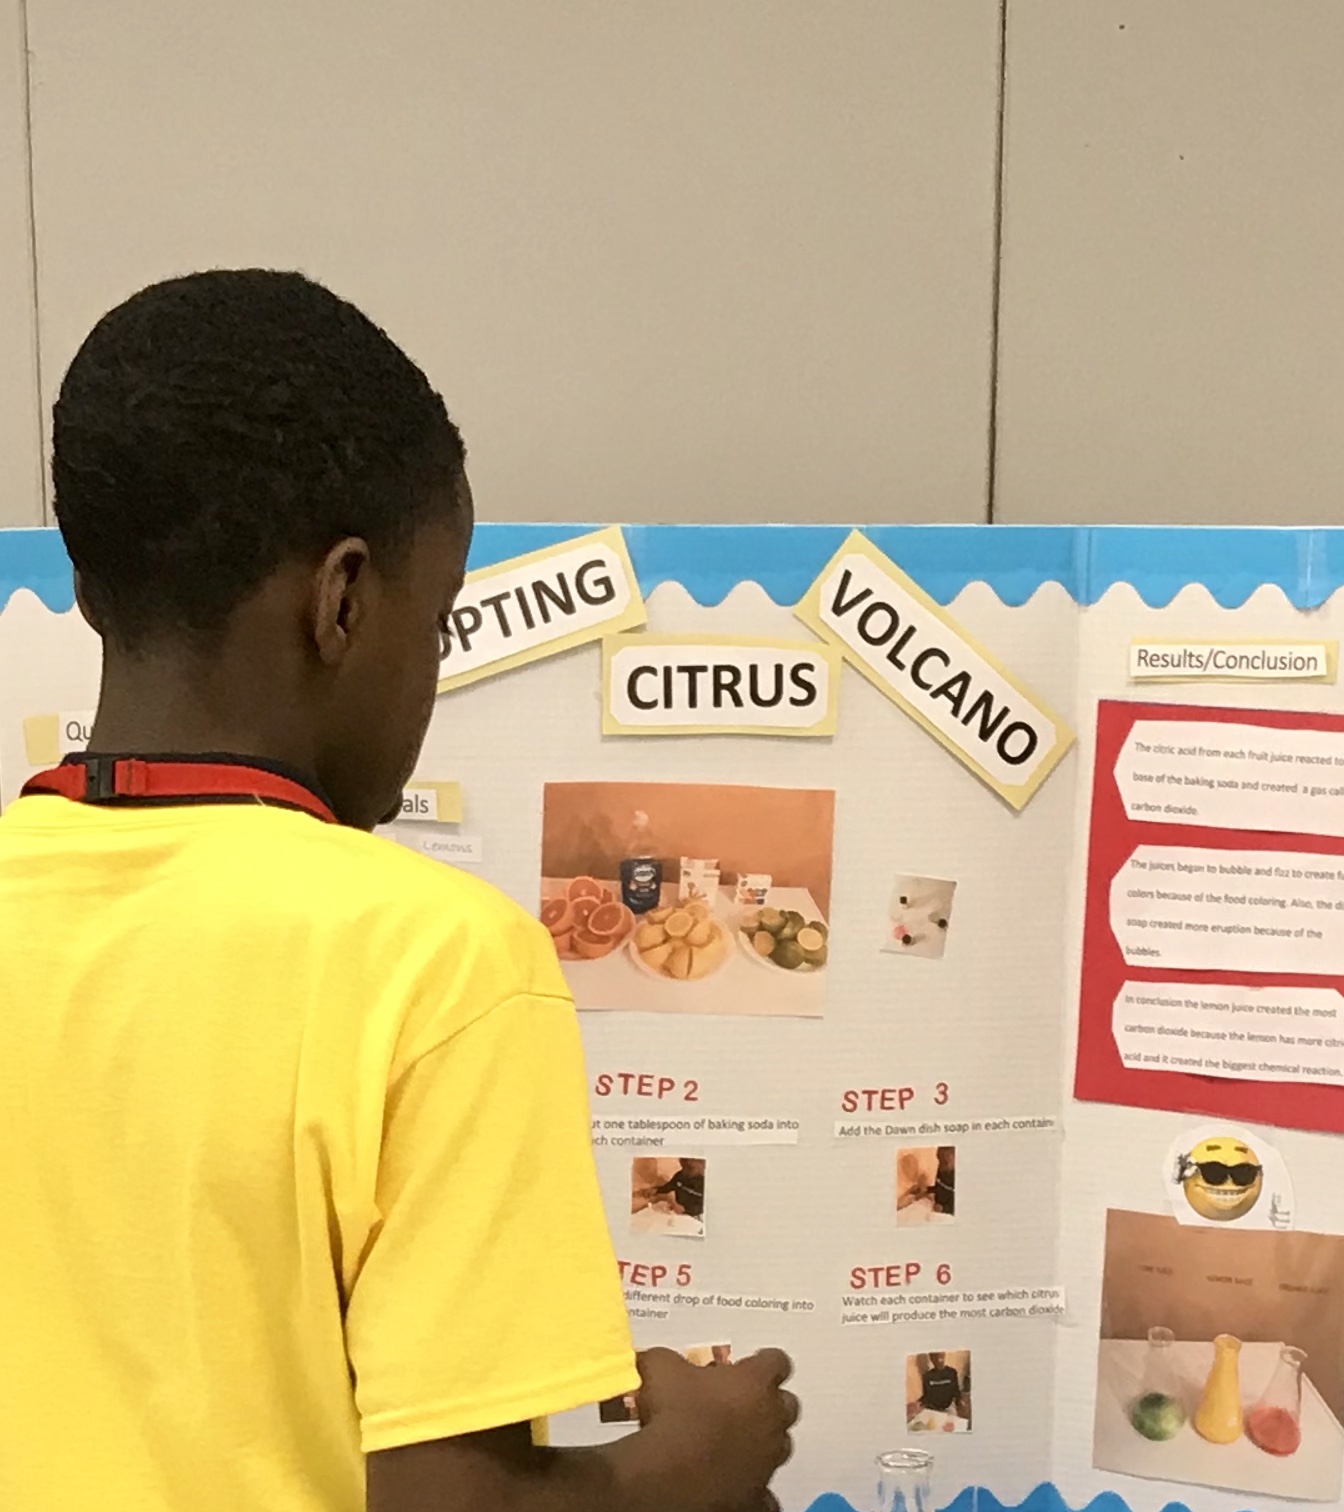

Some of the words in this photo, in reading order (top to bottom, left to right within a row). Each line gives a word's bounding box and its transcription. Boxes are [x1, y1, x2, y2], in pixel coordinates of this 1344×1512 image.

[831, 569, 1038, 765] VOLCANO
[1138, 649, 1317, 671] Results/Conclusion
[627, 662, 817, 710] CITRUS
[1135, 742, 1152, 753] The
[1154, 744, 1174, 754] citric
[1178, 746, 1196, 756] acid
[1199, 747, 1221, 757] from
[1223, 749, 1245, 759] each
[1249, 751, 1268, 761] fruit
[1270, 752, 1292, 763] juice
[1296, 754, 1332, 766] reacted
[1335, 756, 1344, 766] to
[1133, 772, 1153, 782] base
[1156, 773, 1165, 784] of
[1168, 775, 1182, 785] the
[1184, 776, 1214, 789] baking
[1217, 778, 1238, 789] soda
[1241, 780, 1258, 790] and
[1261, 781, 1297, 793] created
[1311, 786, 1326, 797] gas
[1131, 802, 1161, 812] carbon
[1164, 803, 1199, 815] dioxide.
[1126, 995, 1134, 1003] In
[1137, 995, 1182, 1007] conclusion
[1184, 998, 1199, 1008] the
[1202, 1001, 1229, 1011] lemon
[1232, 1003, 1254, 1014] juice
[1257, 1005, 1292, 1015] created
[1294, 1006, 1309, 1016] the
[1313, 1008, 1337, 1018] most
[1125, 1024, 1155, 1034] carbon
[1158, 1025, 1188, 1036] dioxide
[1191, 1028, 1227, 1040] because
[1229, 1031, 1245, 1041] the
[1247, 1032, 1276, 1042] lemon
[1279, 1033, 1294, 1044] has
[1298, 1037, 1322, 1046] more
[1124, 1052, 1141, 1061] acid
[1144, 1053, 1160, 1063] and
[1163, 1054, 1168, 1063] it
[1171, 1055, 1203, 1067] created
[1205, 1059, 1220, 1068] the
[1223, 1060, 1256, 1072] biggest
[1259, 1062, 1299, 1073] chemical
[1303, 1065, 1343, 1077] reaction.
[596, 1073, 675, 1099] STEP
[683, 1080, 698, 1101] 2
[842, 1088, 914, 1112] STEP
[934, 1082, 949, 1105] 3
[604, 1121, 624, 1129] one
[628, 1119, 690, 1131] tablespoon
[694, 1119, 706, 1129] of
[708, 1119, 745, 1132] baking
[748, 1119, 773, 1129] soda
[777, 1120, 799, 1129] into
[839, 1126, 861, 1136] Add
[864, 1125, 881, 1135] the
[885, 1125, 915, 1135] Dawn
[919, 1123, 940, 1134] dish
[944, 1124, 969, 1133] soap
[972, 1121, 981, 1131] in
[985, 1119, 1009, 1130] each
[1013, 1118, 1054, 1129] contain
[611, 1136, 664, 1146] container
[617, 1261, 667, 1287] TEP
[676, 1264, 691, 1286] 5
[850, 1262, 921, 1289] STEP
[936, 1264, 951, 1285] 6
[673, 1294, 699, 1306] drop
[702, 1295, 714, 1305] of
[717, 1296, 742, 1307] food
[745, 1298, 789, 1311] coloring
[792, 1301, 814, 1311] into
[842, 1296, 877, 1307] Watch
[880, 1295, 905, 1305] each
[909, 1293, 959, 1304] container
[963, 1292, 973, 1302] to
[977, 1293, 994, 1301] see
[998, 1290, 1028, 1300] which
[628, 1308, 668, 1318] ntainer
[842, 1312, 867, 1324] juice
[871, 1311, 888, 1321] will
[892, 1310, 936, 1323] produce
[939, 1309, 956, 1319] the
[960, 1308, 986, 1317] most
[989, 1306, 1025, 1316] carbon
